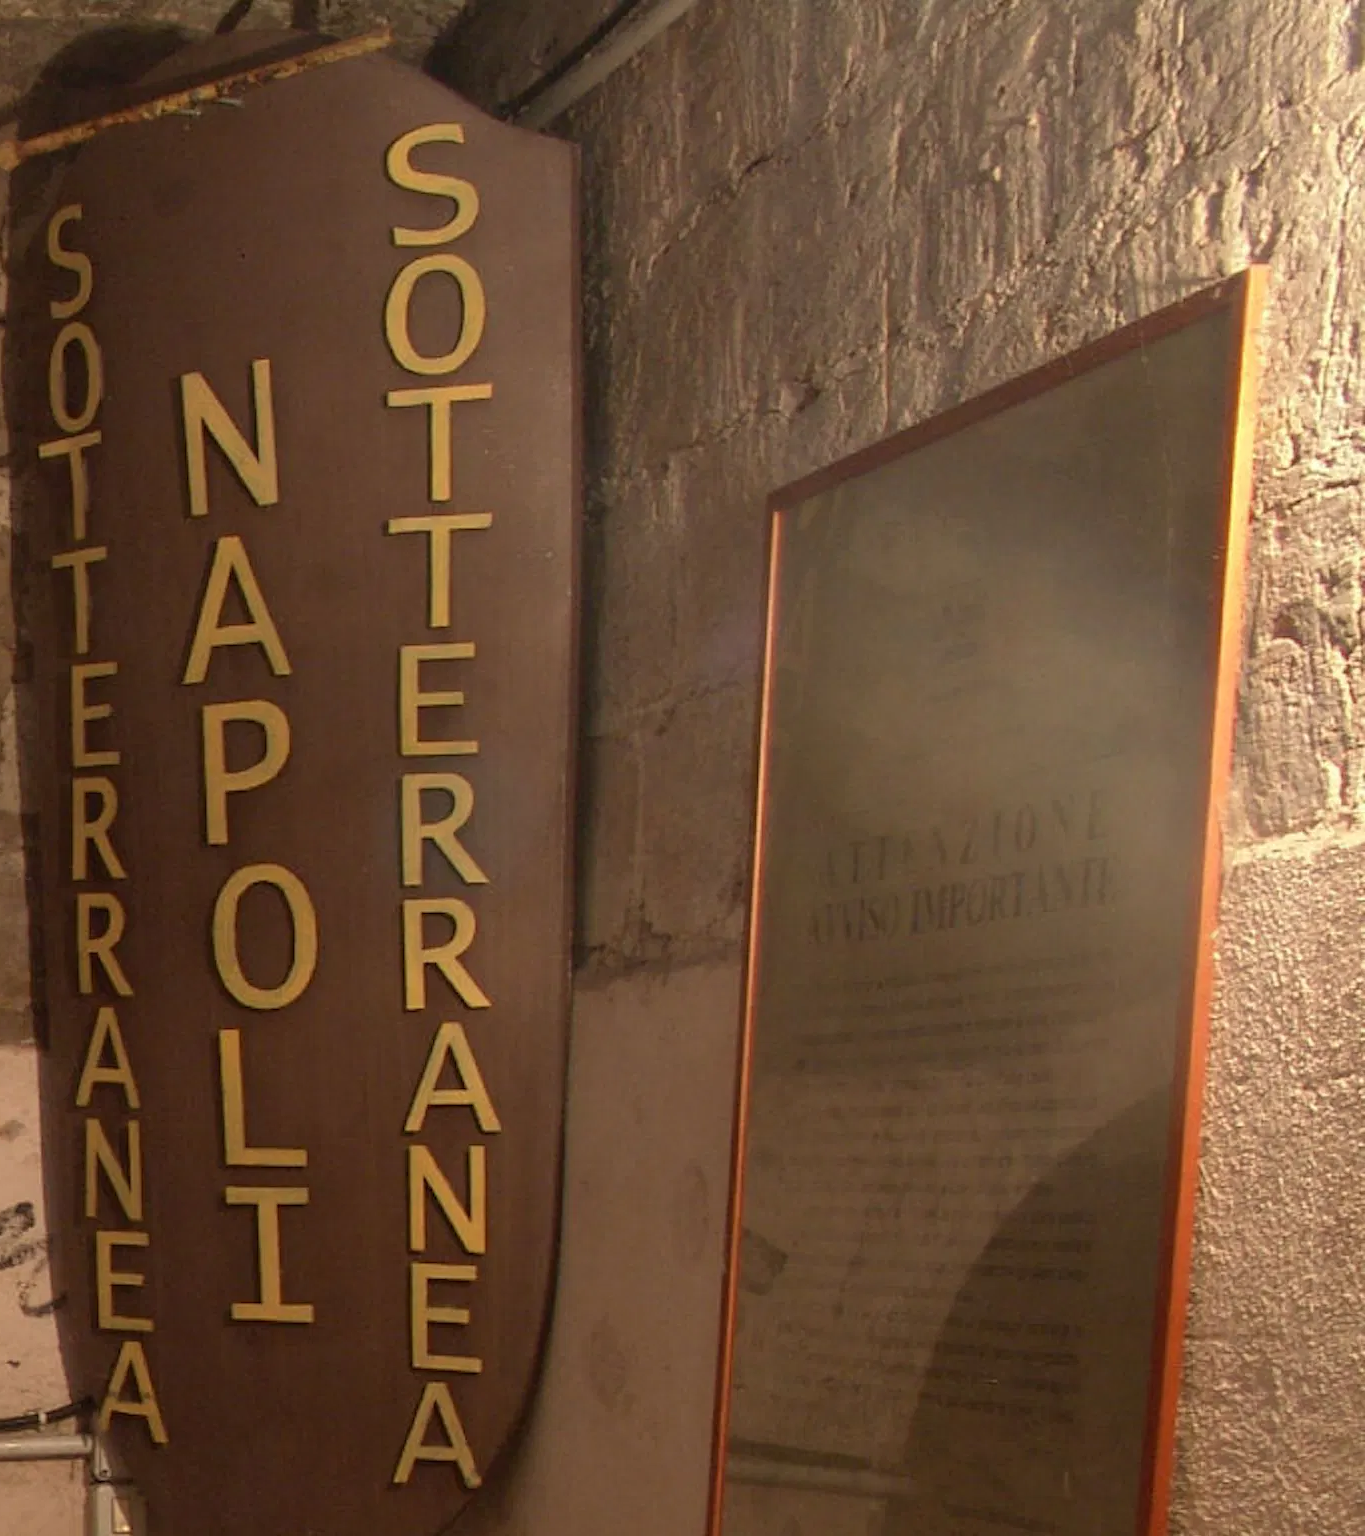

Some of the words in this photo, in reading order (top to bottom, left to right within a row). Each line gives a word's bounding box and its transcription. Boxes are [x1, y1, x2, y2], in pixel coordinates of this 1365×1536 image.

[38, 203, 169, 1445] SOTTERRANEA
[180, 358, 316, 1324] NAPOLI
[384, 122, 502, 1488] SOTTERRANEA
